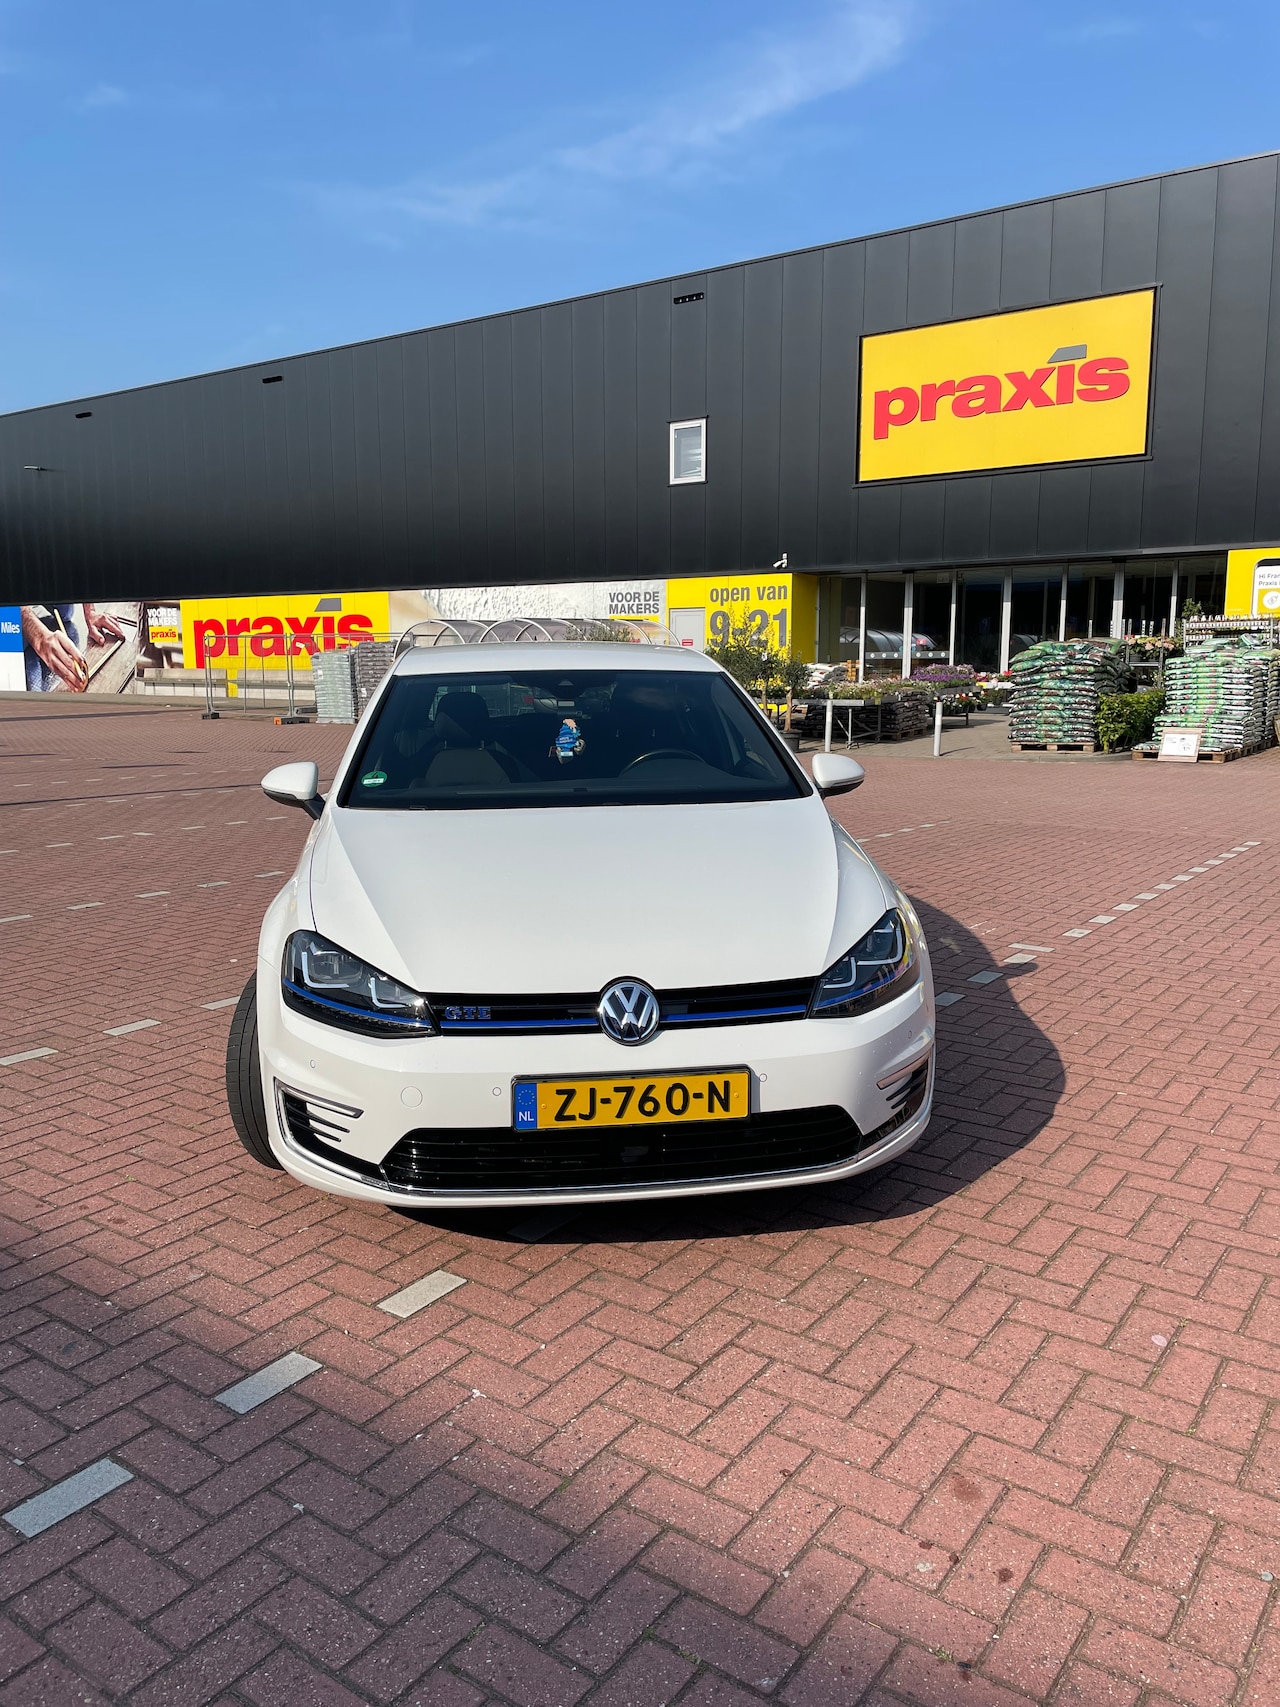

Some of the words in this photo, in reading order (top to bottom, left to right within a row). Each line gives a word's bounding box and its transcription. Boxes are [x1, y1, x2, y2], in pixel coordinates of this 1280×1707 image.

[873, 344, 1131, 440] praxis
[609, 592, 641, 603] VOOR
[643, 591, 660, 602] DE
[709, 586, 750, 606] open
[757, 585, 788, 600] van
[147, 607, 167, 618] VOOR
[168, 607, 178, 617] DE
[609, 602, 660, 614] MAKERS
[0, 621, 21, 634] Miles
[148, 617, 178, 627] MAKERS
[709, 608, 788, 648] 9-21
[151, 628, 177, 640] praxis
[193, 597, 375, 669] praxis
[444, 1005, 492, 1020] GTE
[554, 1080, 731, 1122] ZJ-760-N
[518, 1110, 535, 1122] NL
